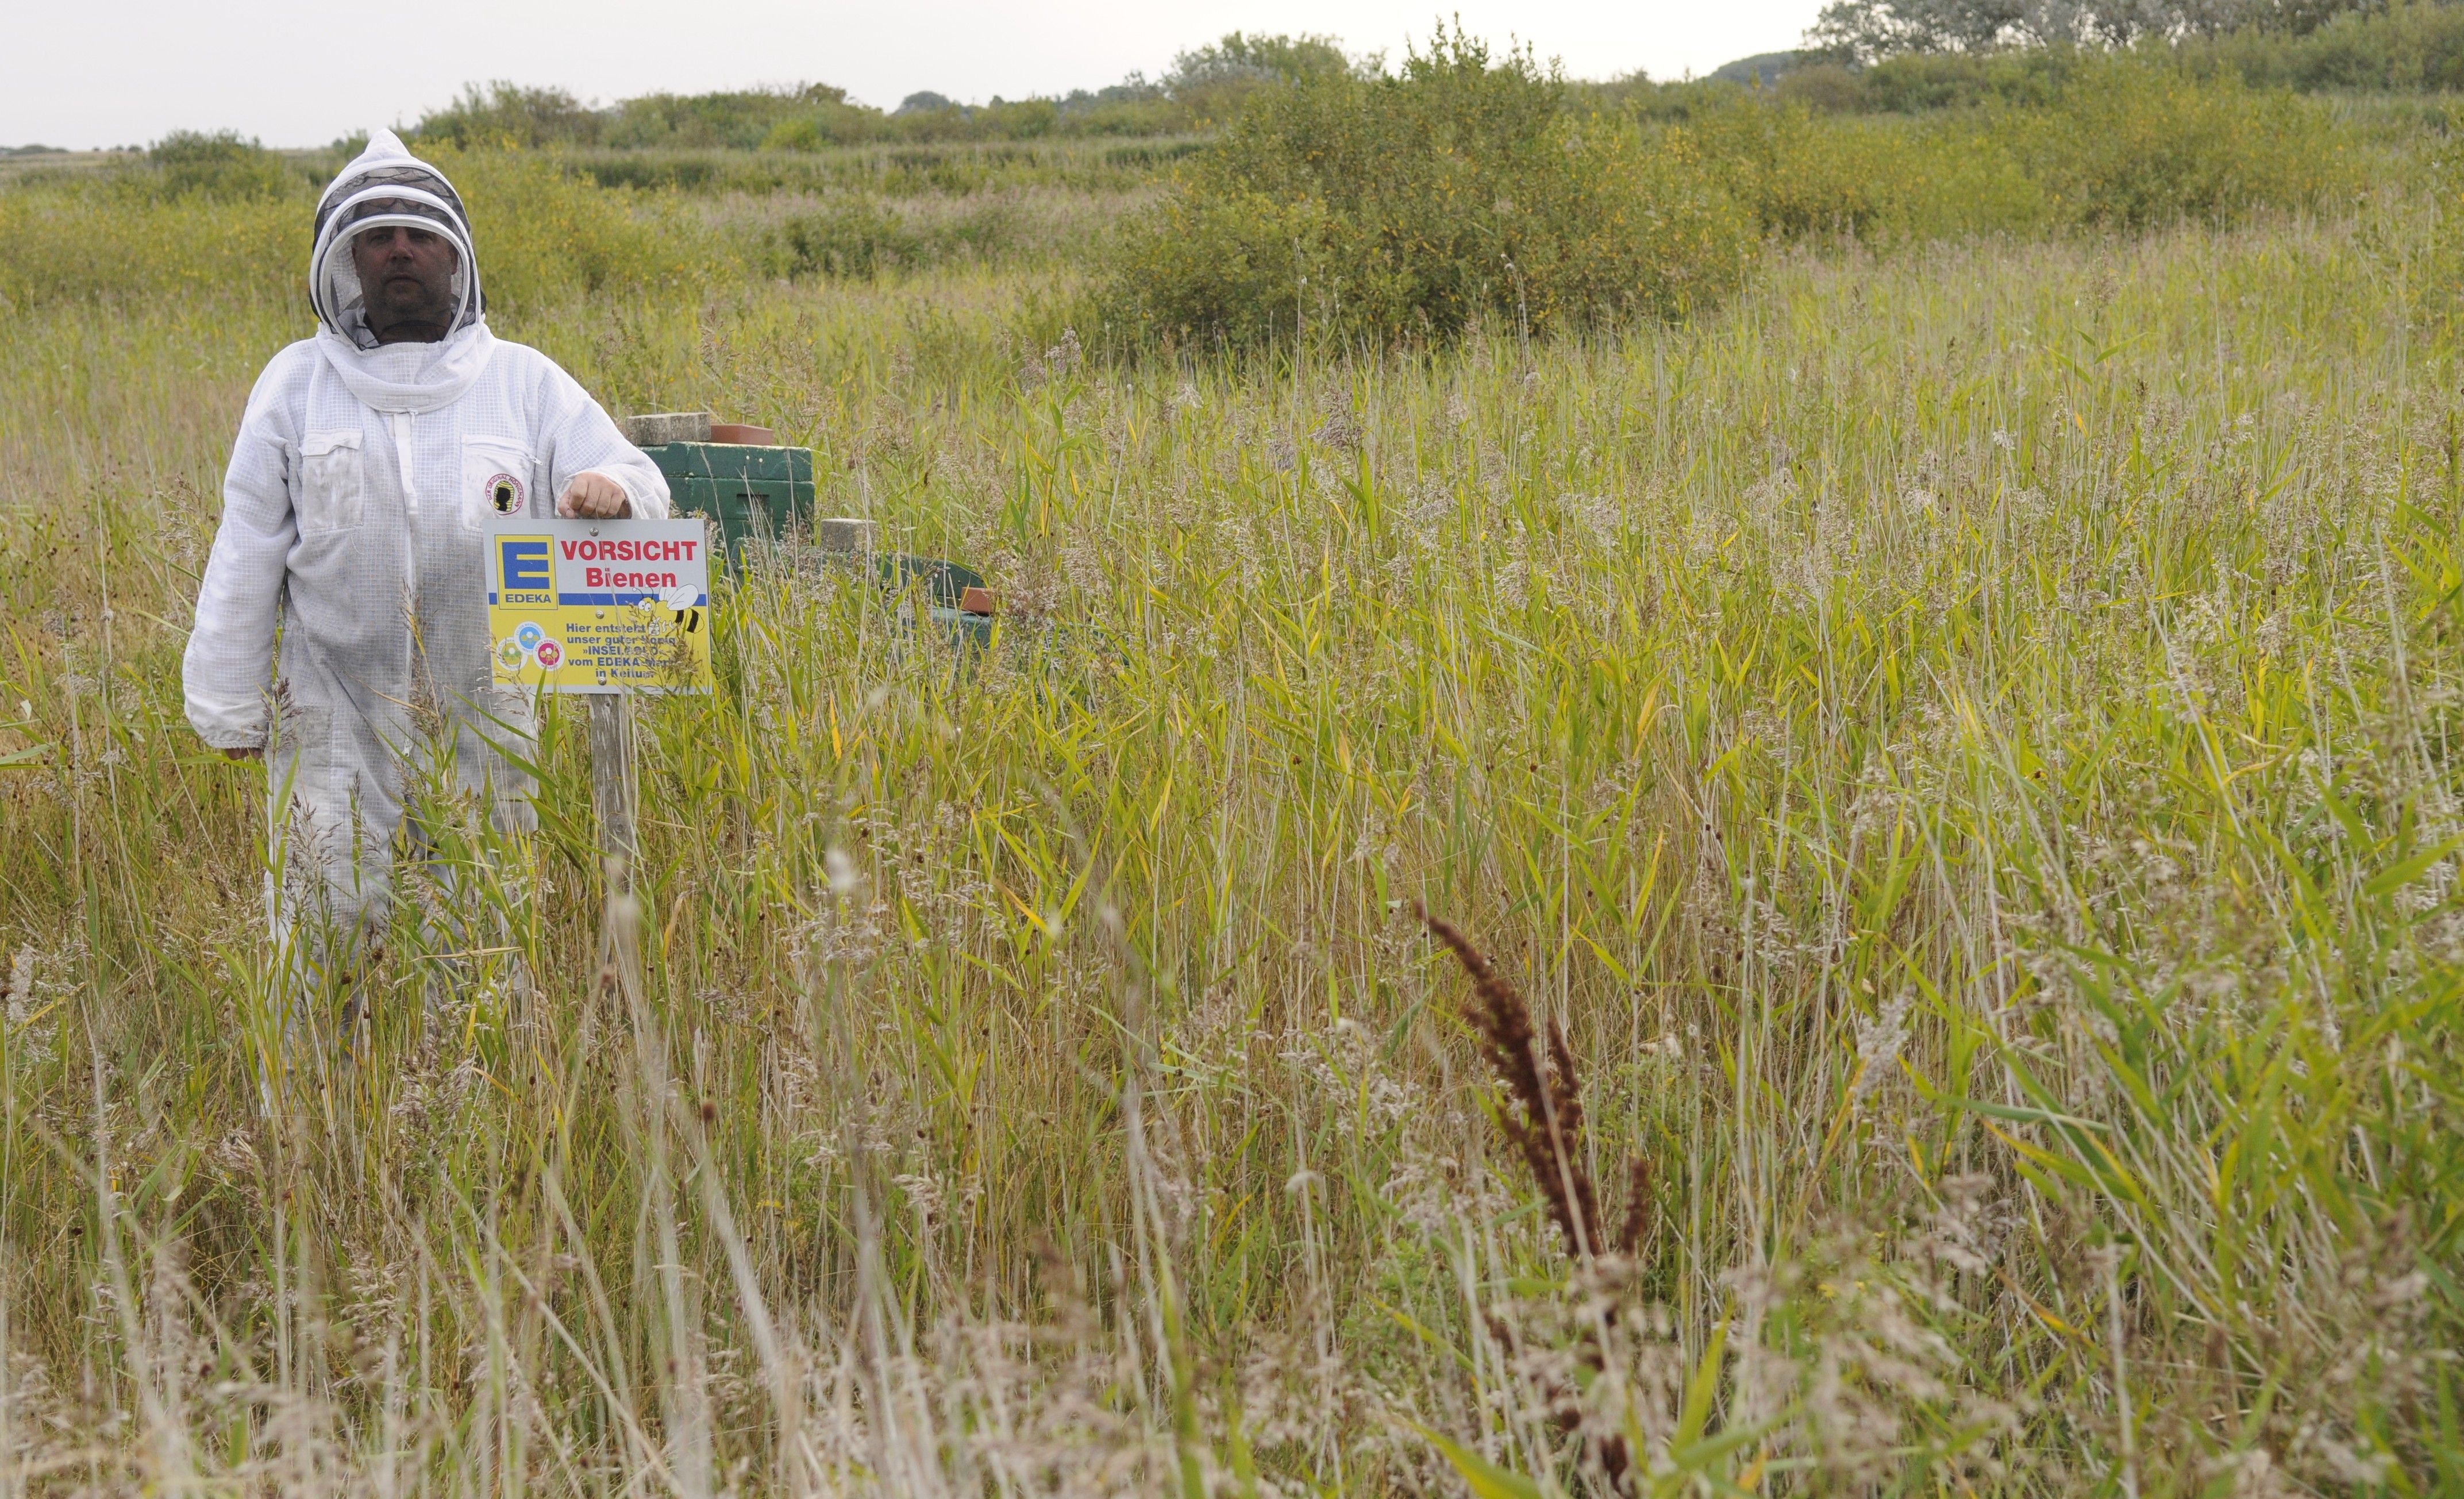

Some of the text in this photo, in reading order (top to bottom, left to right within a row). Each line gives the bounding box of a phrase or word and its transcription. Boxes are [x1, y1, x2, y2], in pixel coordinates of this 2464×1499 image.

[488, 475, 508, 489] ORIGINAL
[560, 540, 697, 561] VORSICHT
[586, 567, 676, 587] Bienen
[505, 594, 552, 603] EDEKA
[566, 623, 591, 633] Hier
[567, 636, 601, 644] unser
[605, 635, 638, 646] guter
[568, 658, 593, 666] vom
[595, 668, 606, 678] in
